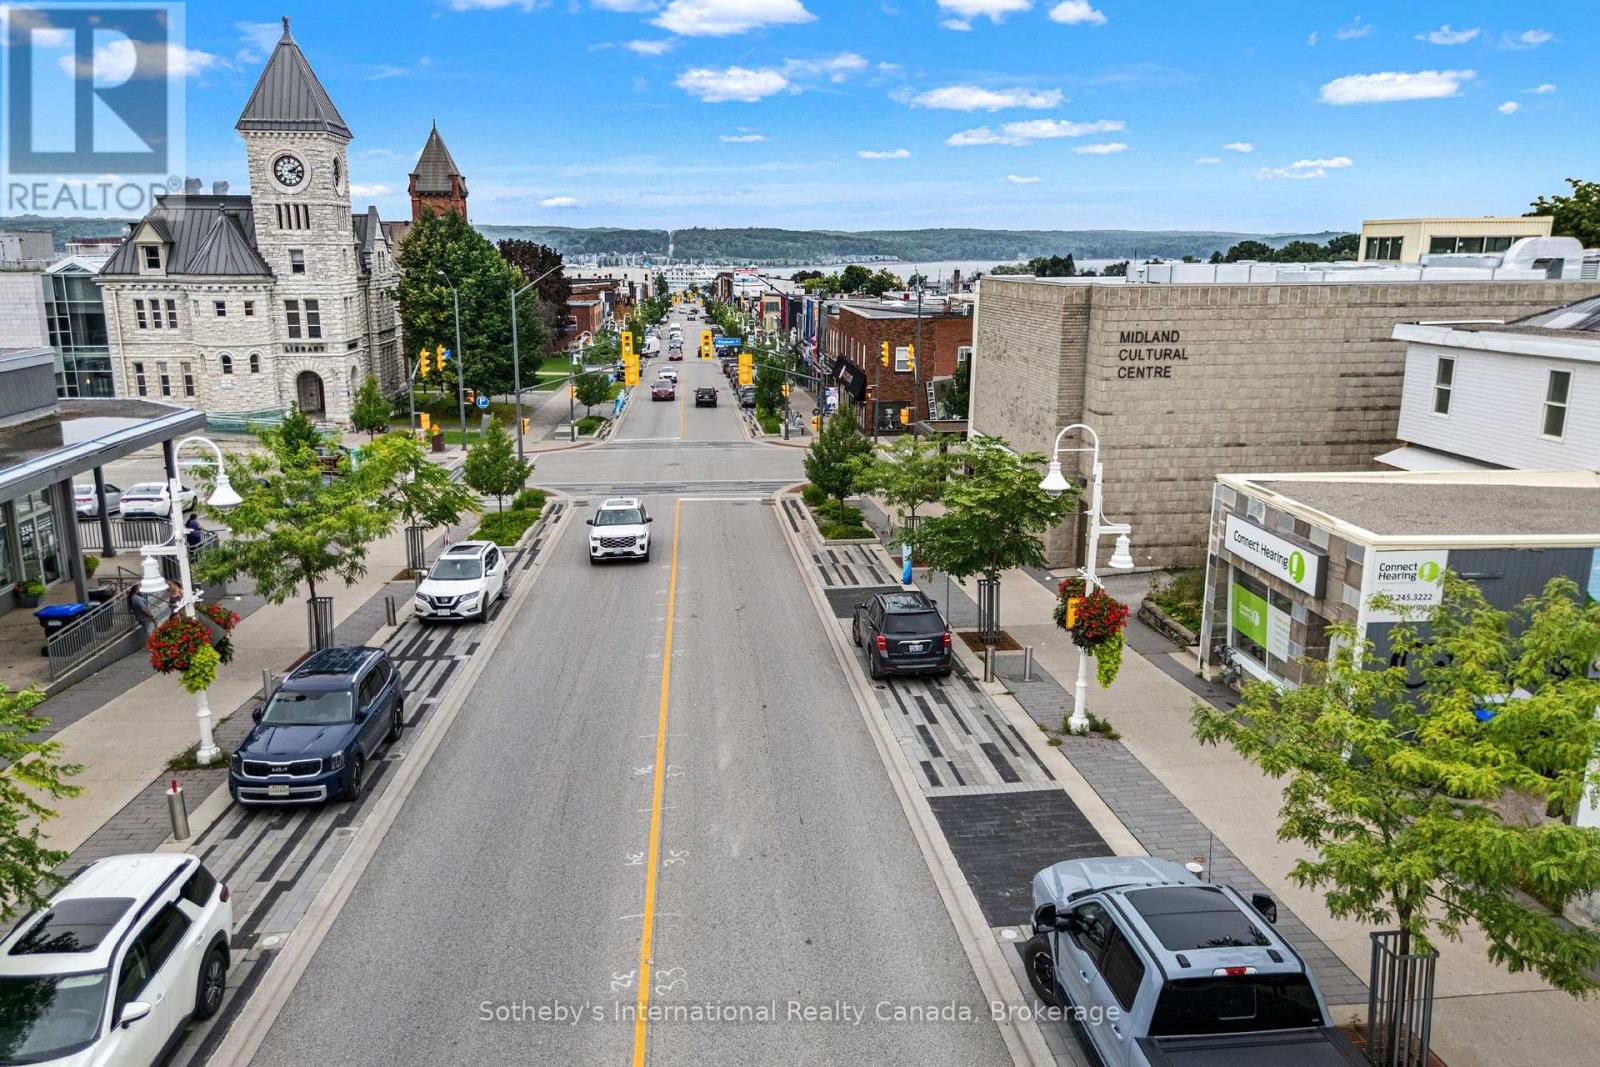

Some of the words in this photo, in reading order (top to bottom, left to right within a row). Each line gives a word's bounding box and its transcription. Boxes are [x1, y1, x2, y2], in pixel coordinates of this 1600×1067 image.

[1120, 330, 1180, 343] MIDLAND
[285, 345, 325, 353] LIBRARY
[1119, 348, 1189, 361] CULTURAL
[1118, 365, 1171, 378] CENTRE
[1233, 530, 1260, 552] Connect
[1260, 543, 1289, 570] Hearing
[1379, 562, 1418, 572] Connect
[1378, 571, 1417, 582] Hearing
[624, 851, 646, 866] 34
[664, 850, 690, 867] 35
[610, 969, 637, 992] 32
[655, 967, 688, 996] 33
